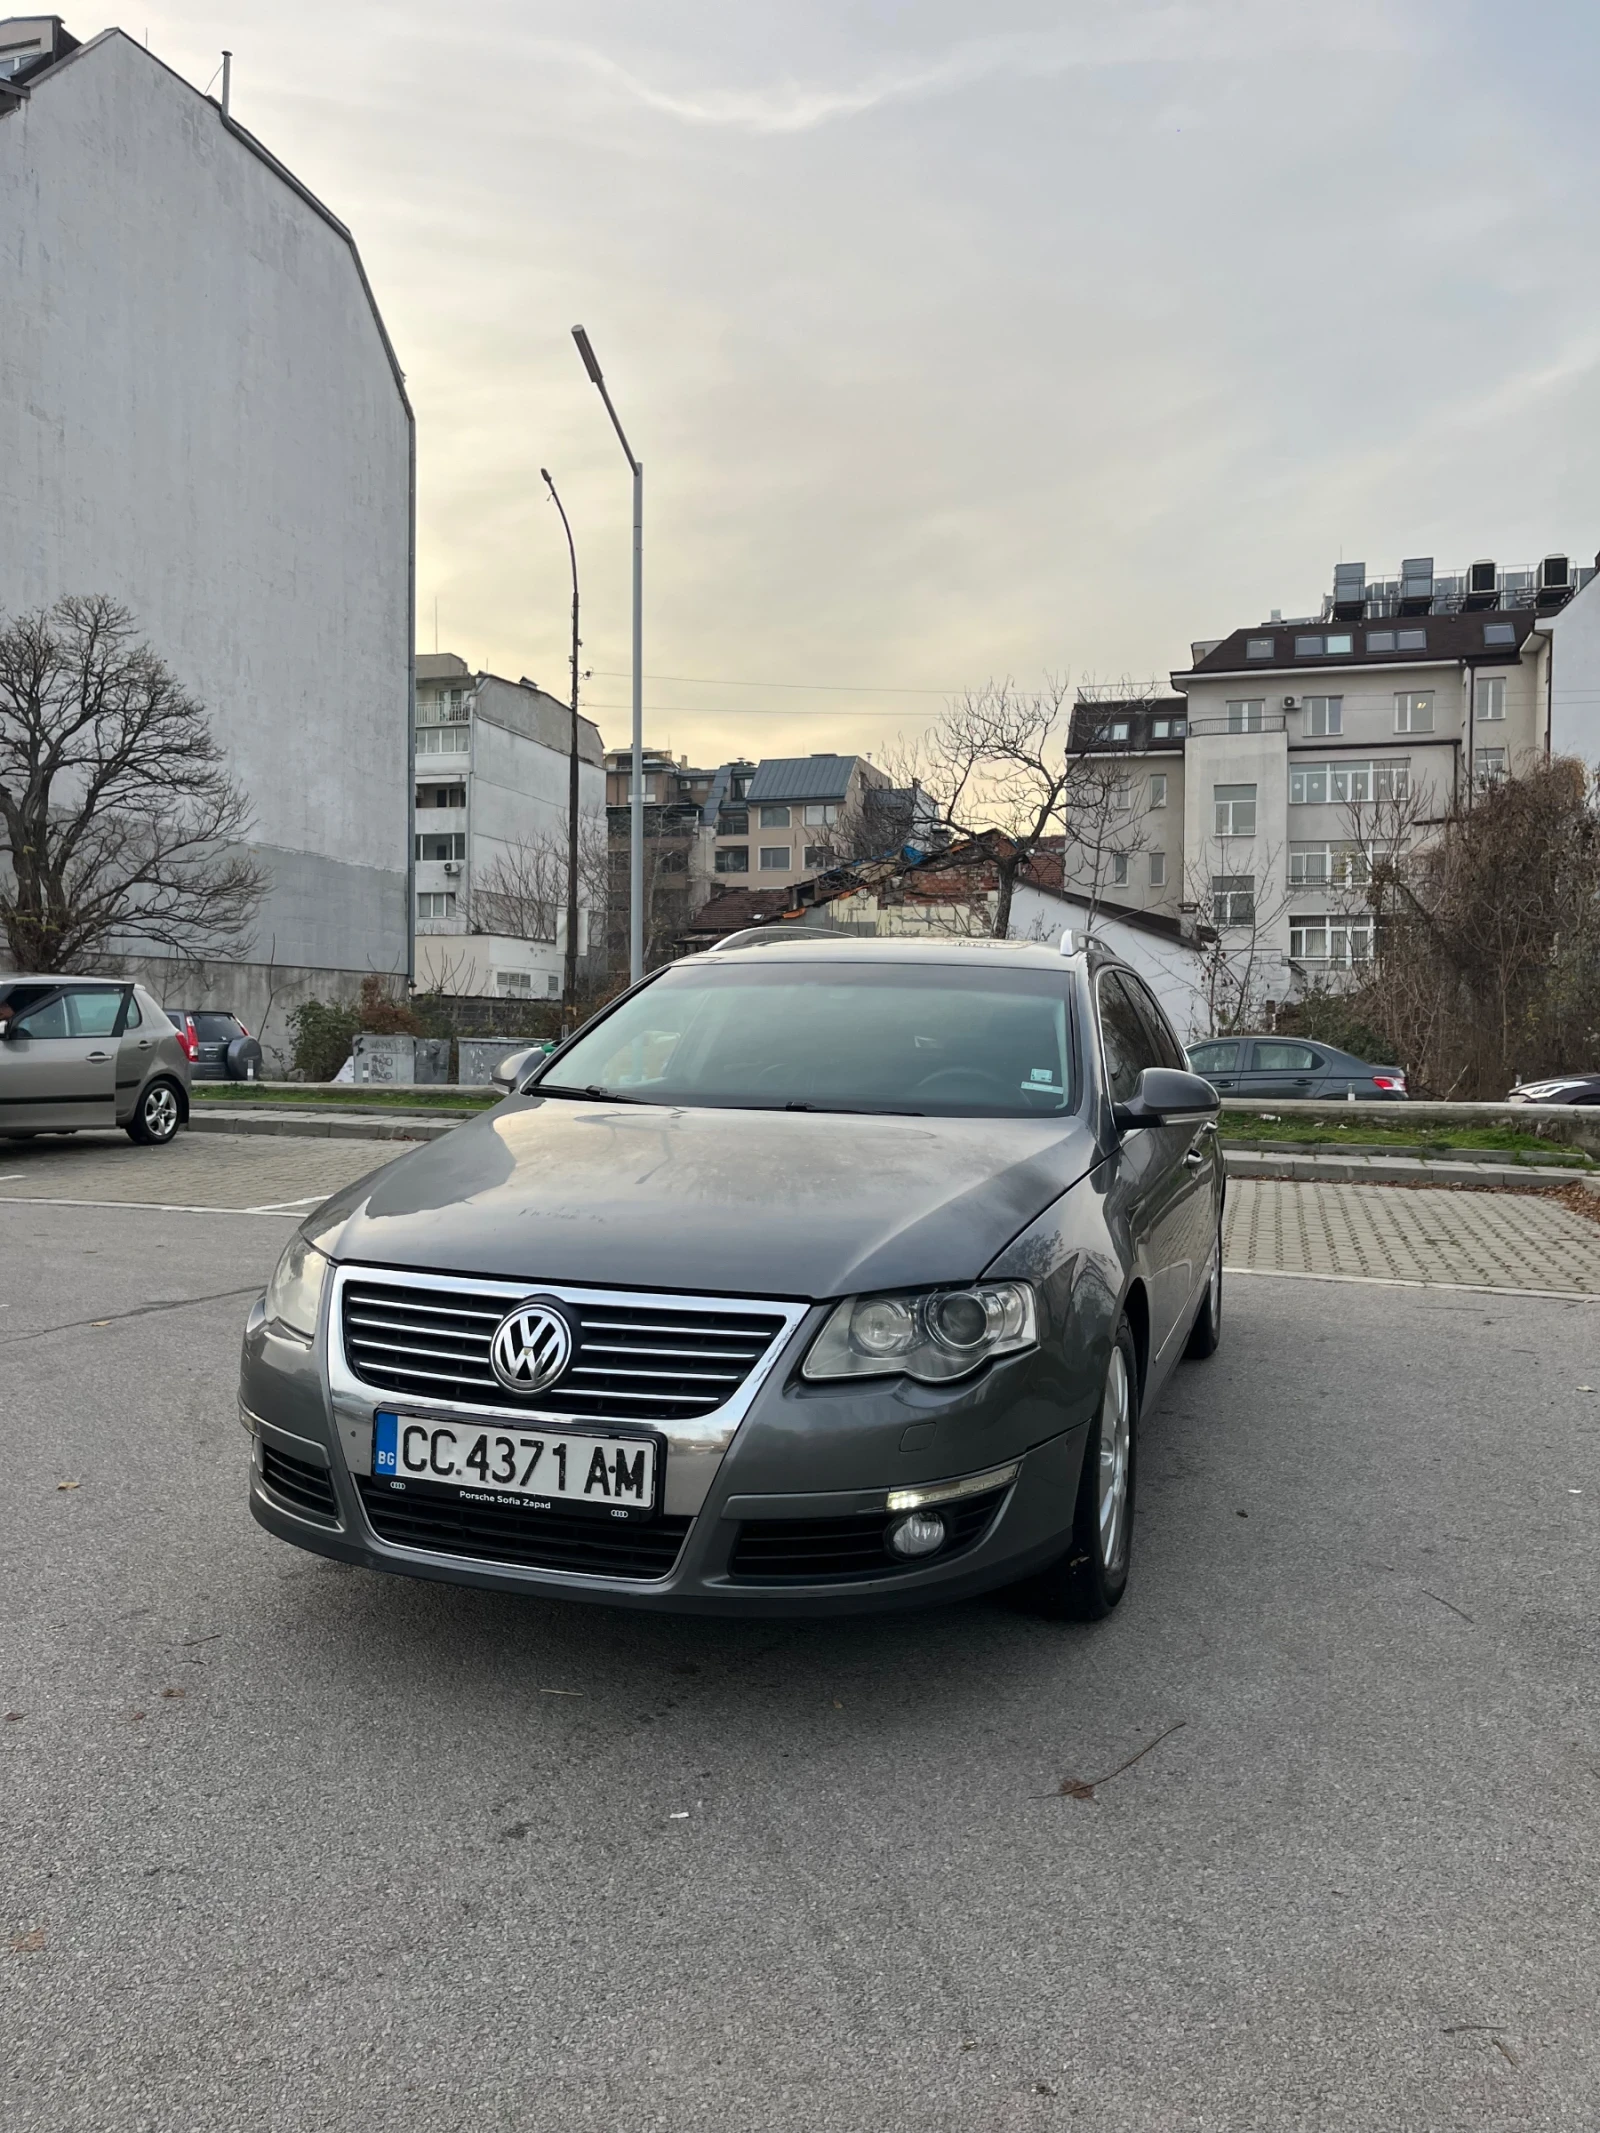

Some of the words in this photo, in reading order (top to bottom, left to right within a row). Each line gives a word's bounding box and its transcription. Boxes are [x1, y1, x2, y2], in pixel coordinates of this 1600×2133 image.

[377, 1450, 395, 1466] BG
[460, 1490, 495, 1502] Porsche
[497, 1495, 520, 1506] Sofia
[522, 1498, 551, 1509] Zapad
